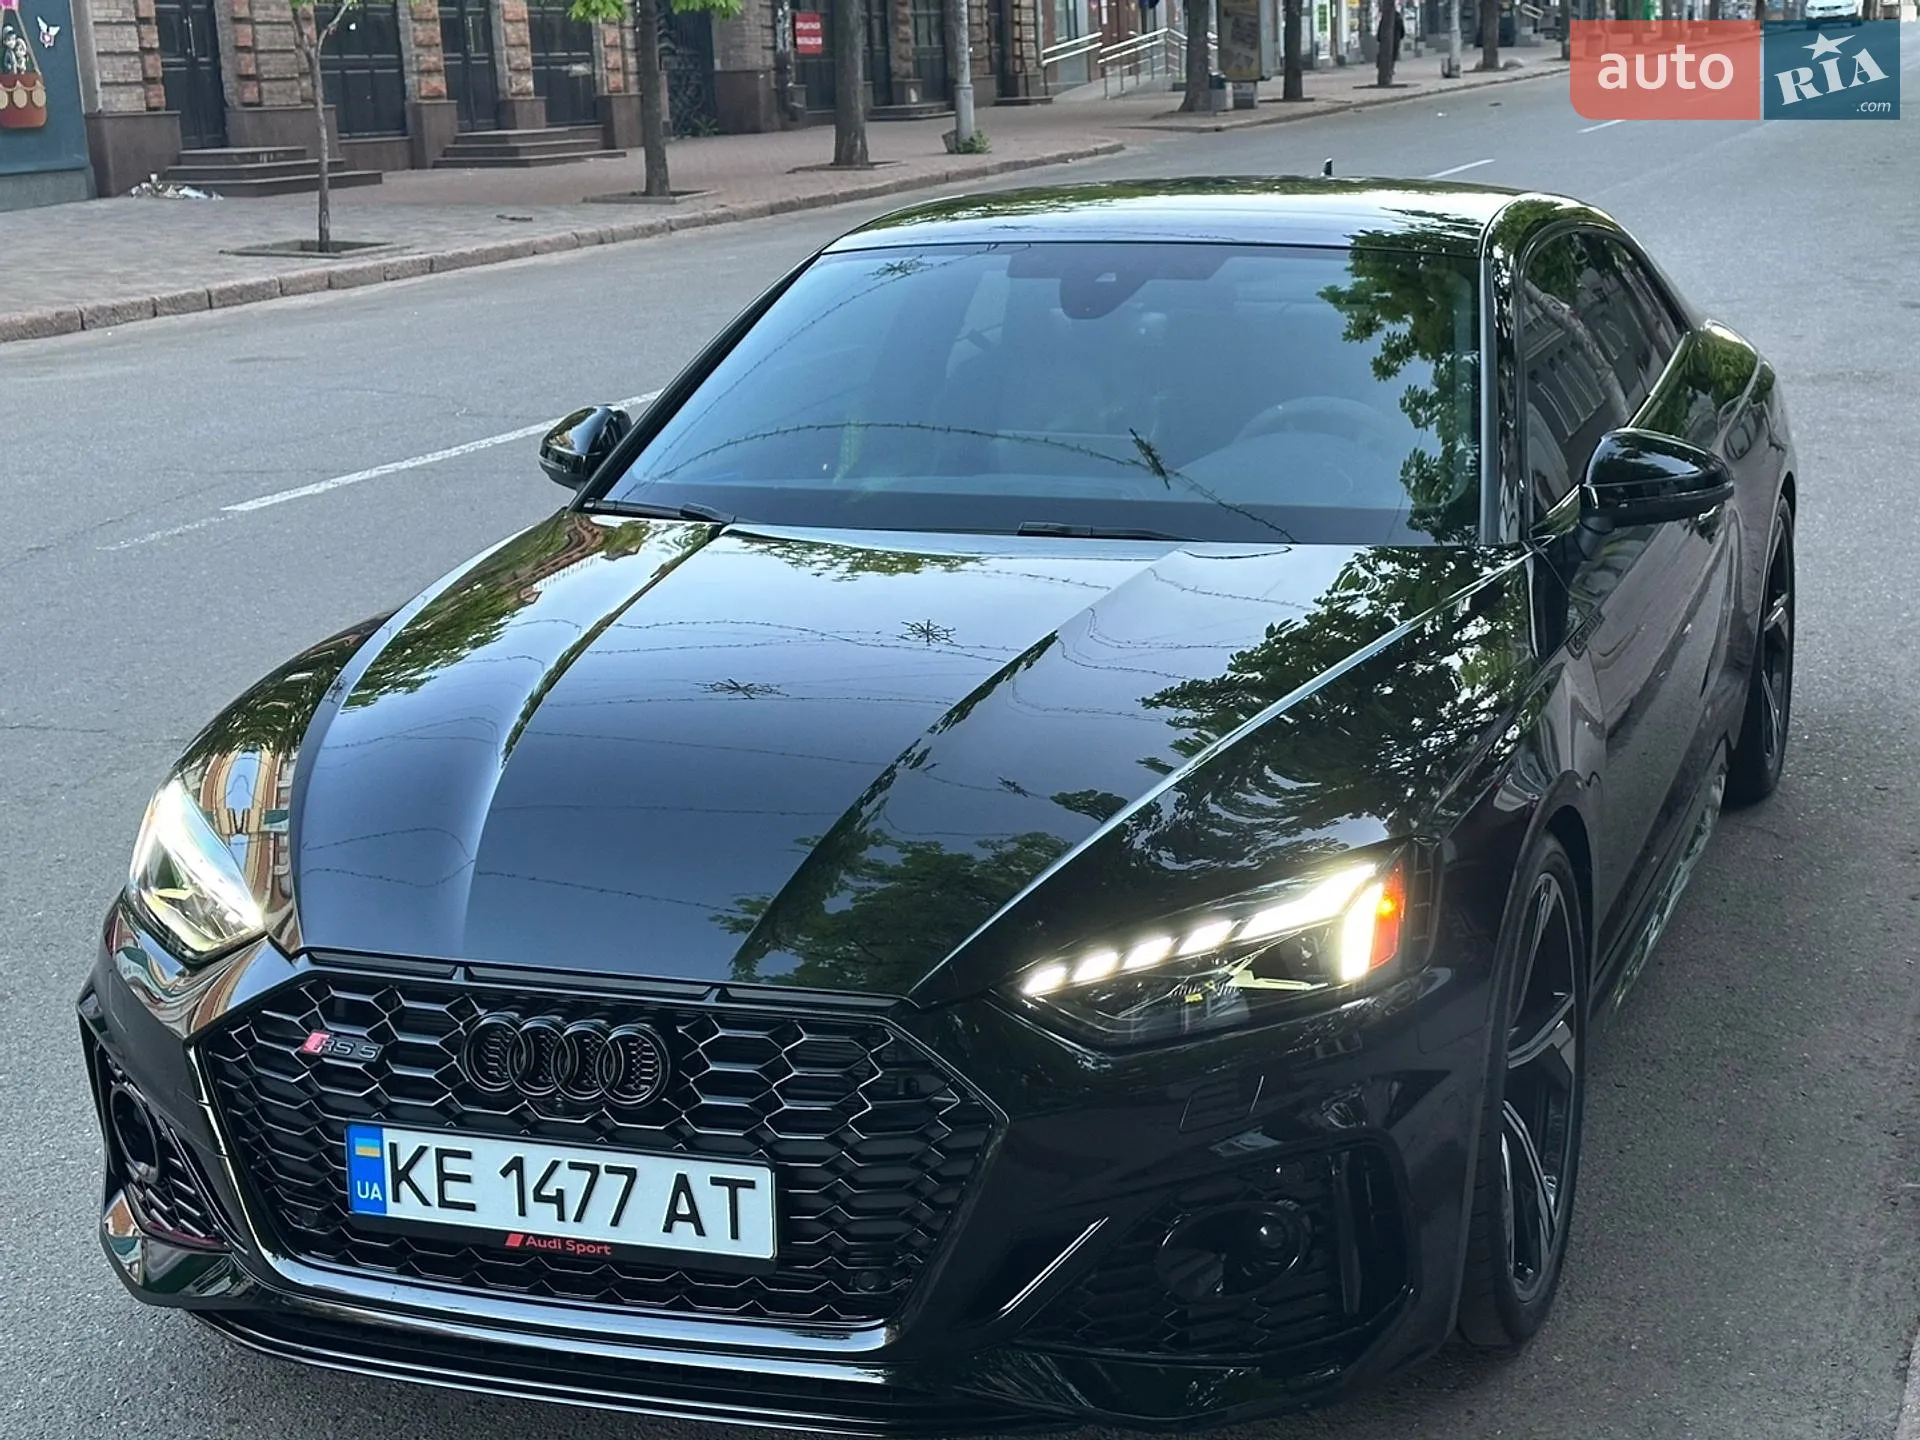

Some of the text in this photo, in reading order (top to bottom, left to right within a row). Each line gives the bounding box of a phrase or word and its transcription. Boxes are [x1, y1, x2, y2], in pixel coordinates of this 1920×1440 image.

[357, 1180, 383, 1201] UA
[388, 1141, 756, 1241] KE 1477 AT
[525, 1235, 612, 1256] Audi Sport
